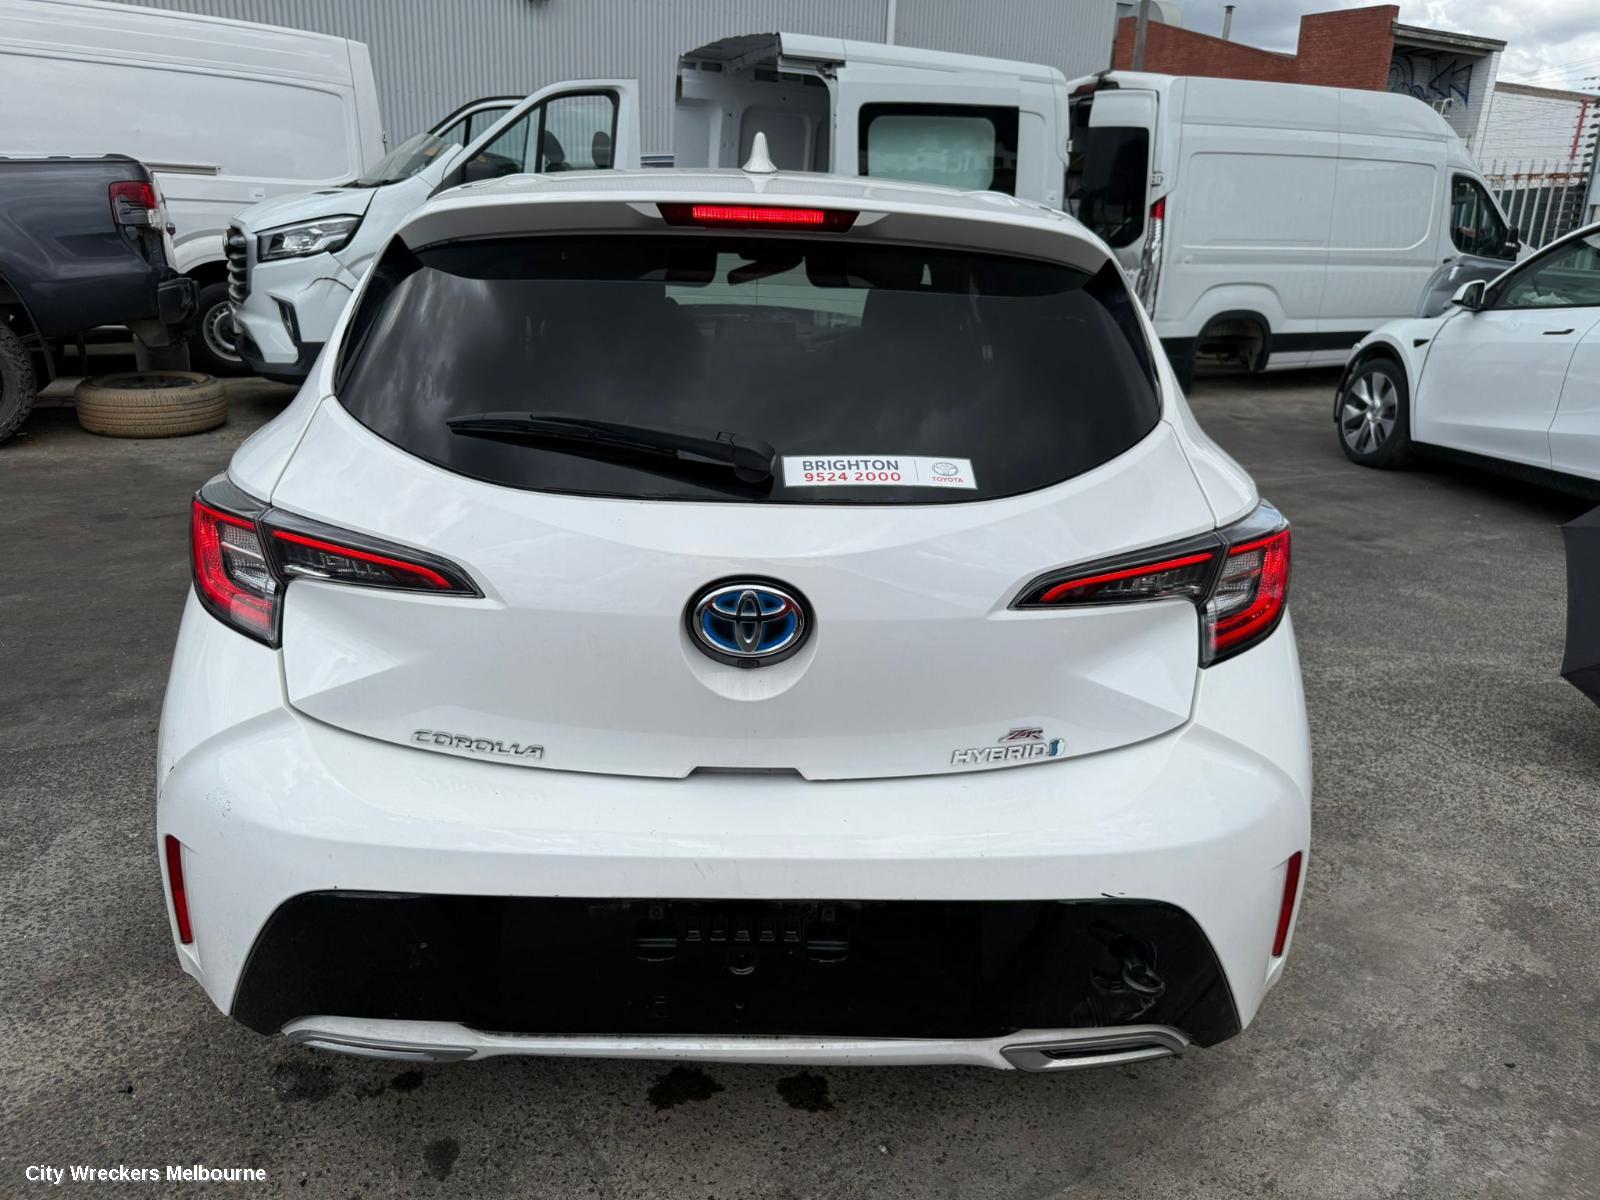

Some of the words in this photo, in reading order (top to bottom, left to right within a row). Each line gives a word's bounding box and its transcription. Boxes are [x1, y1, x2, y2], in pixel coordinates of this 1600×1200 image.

[802, 459, 899, 472] BRIGHTON
[804, 472, 848, 482] 9524
[855, 472, 901, 482] 2000
[998, 727, 1044, 742] ZR
[410, 729, 545, 760] COROLLA
[951, 743, 1047, 766] HYBRID
